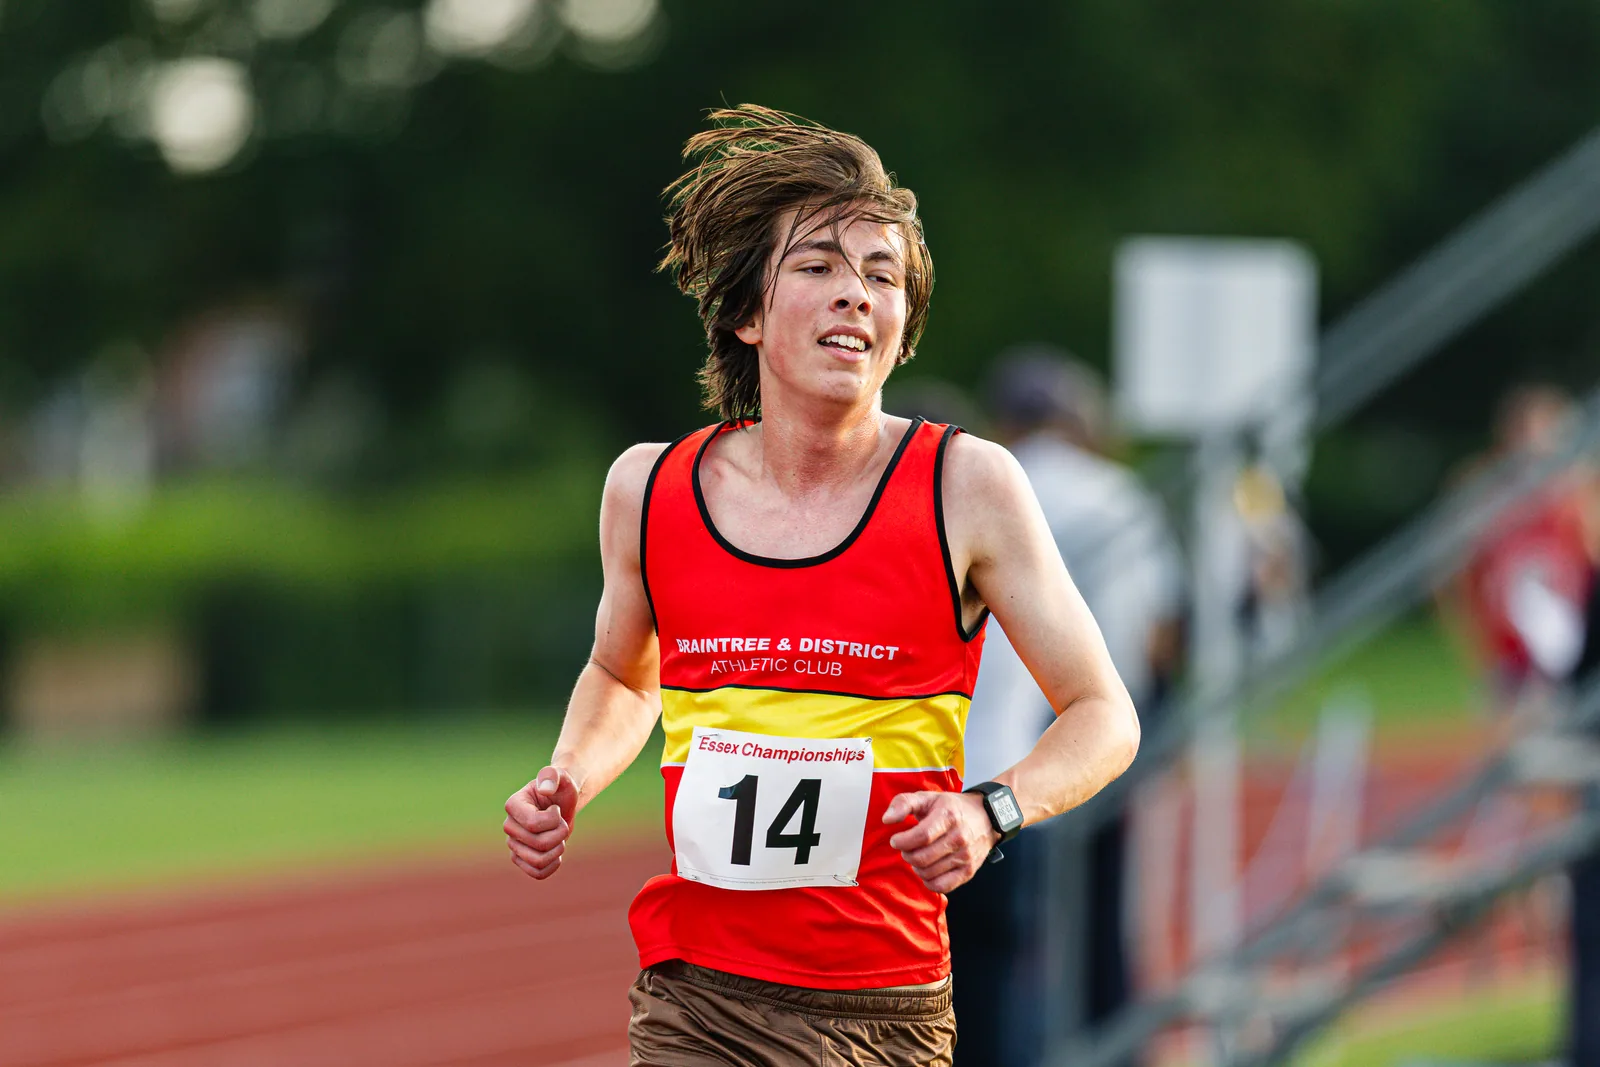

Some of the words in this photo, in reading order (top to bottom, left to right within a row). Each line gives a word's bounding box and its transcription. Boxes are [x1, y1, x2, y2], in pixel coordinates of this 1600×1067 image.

[676, 638, 771, 653] BRAINTREE
[777, 638, 792, 651] &
[799, 638, 899, 660] DISTRICT
[710, 657, 787, 674] ATHLETIC
[793, 659, 843, 676] CLUB
[698, 736, 739, 755] Essex
[741, 742, 865, 764] Championships
[718, 774, 822, 866] 14
